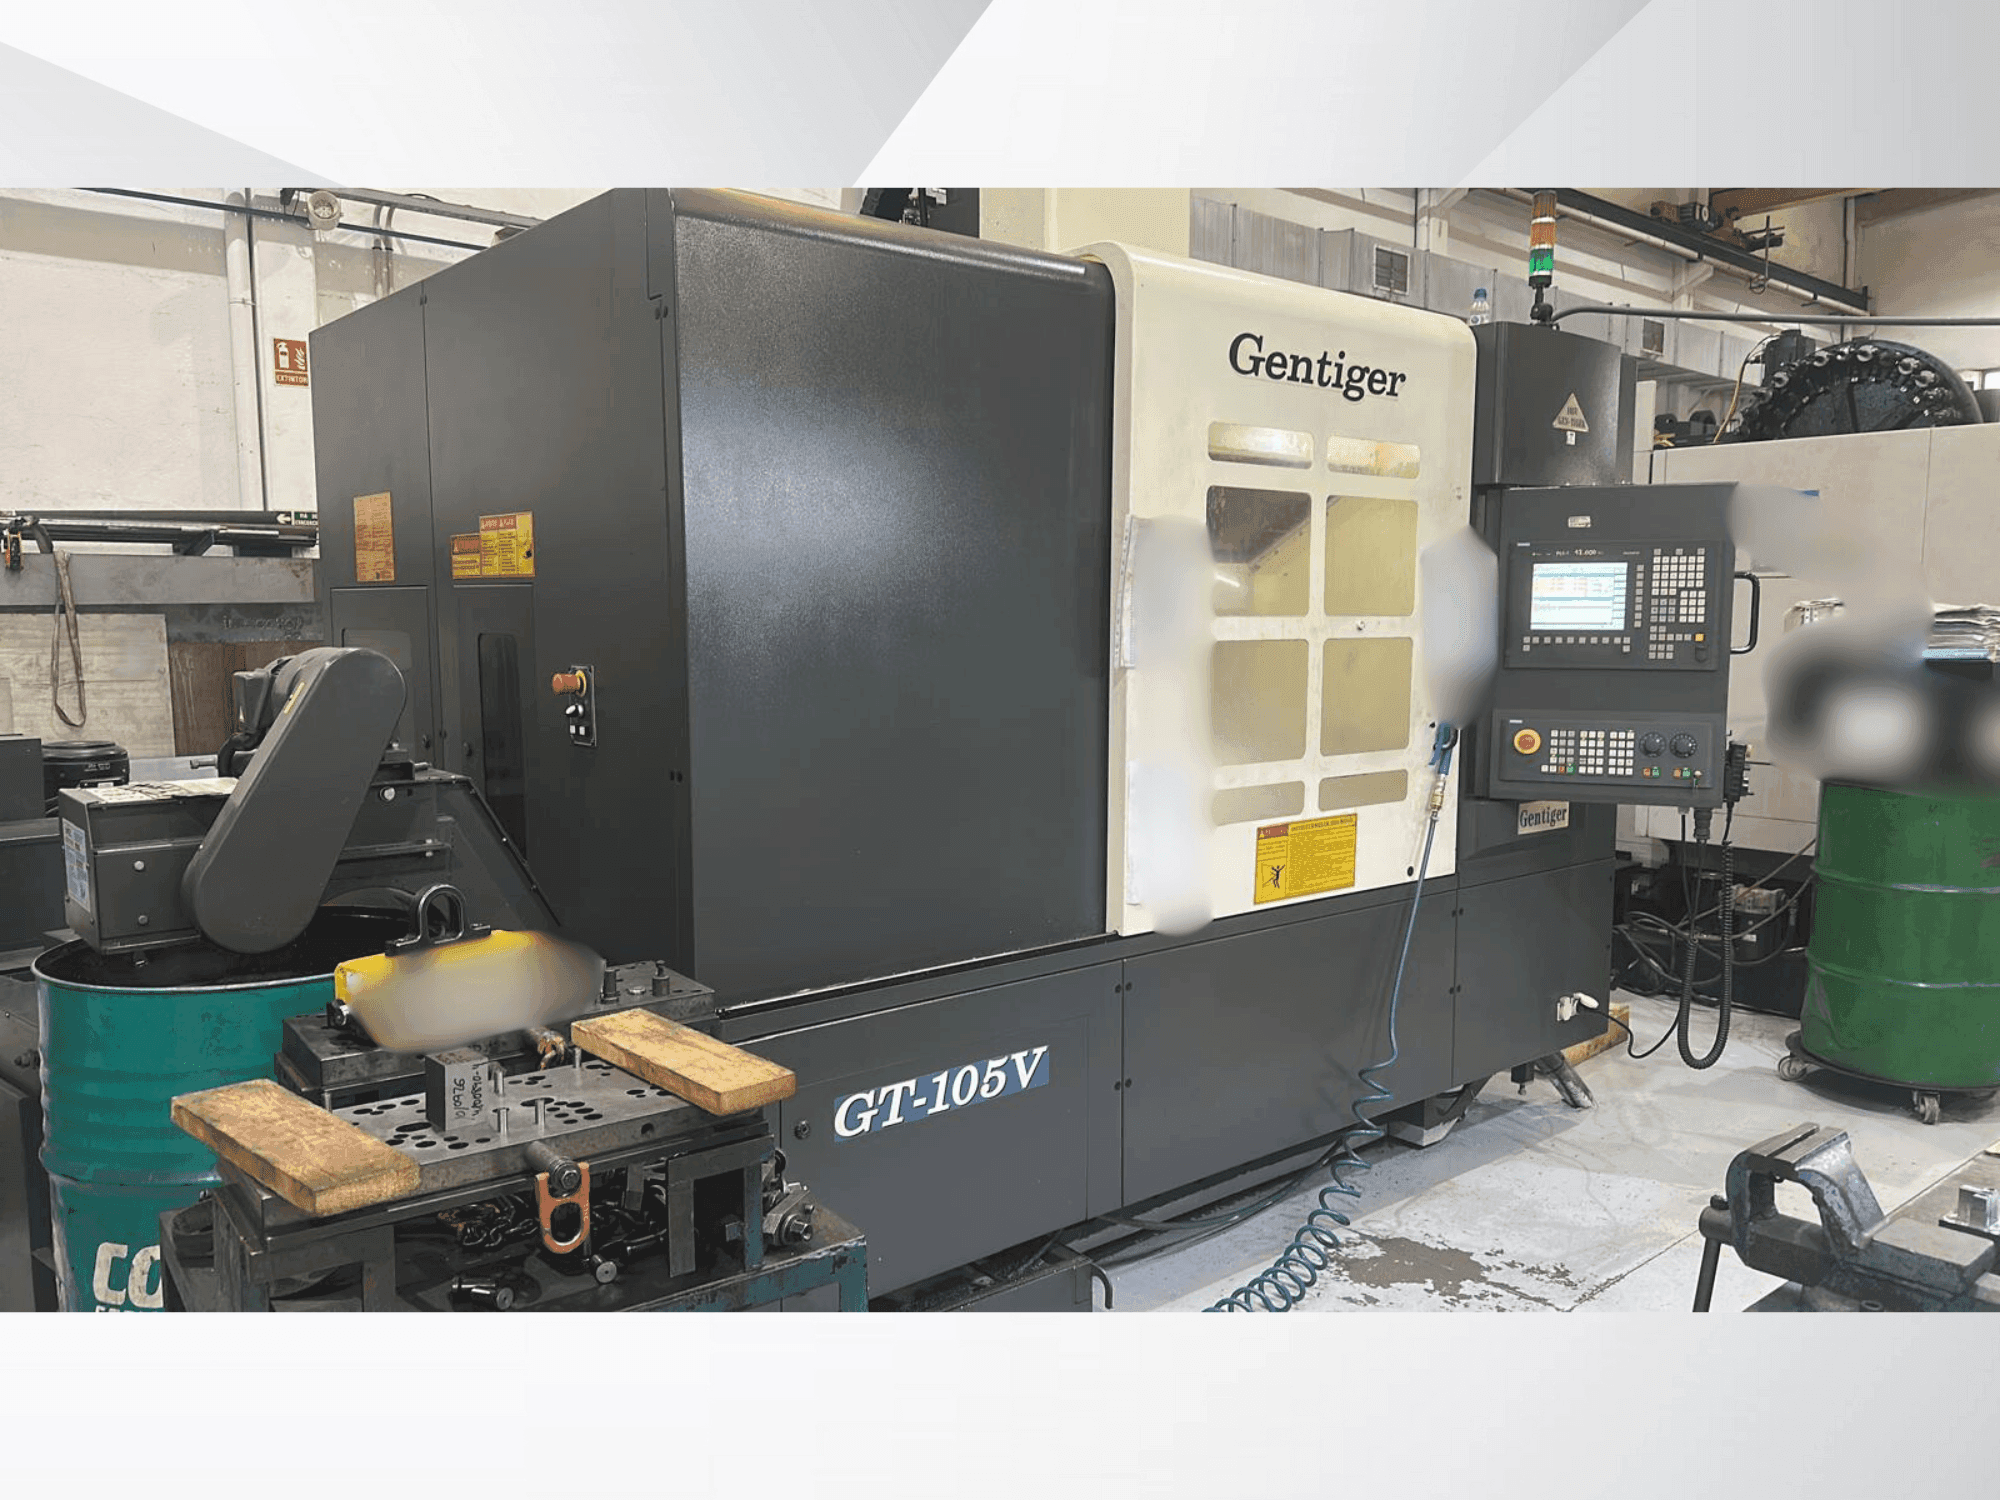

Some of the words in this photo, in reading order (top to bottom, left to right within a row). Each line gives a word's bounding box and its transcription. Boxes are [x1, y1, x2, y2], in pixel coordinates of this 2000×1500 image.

[1229, 332, 1407, 401] Gentiger
[1520, 806, 1567, 828] Gentiger
[834, 1045, 1049, 1138] GT-105V
